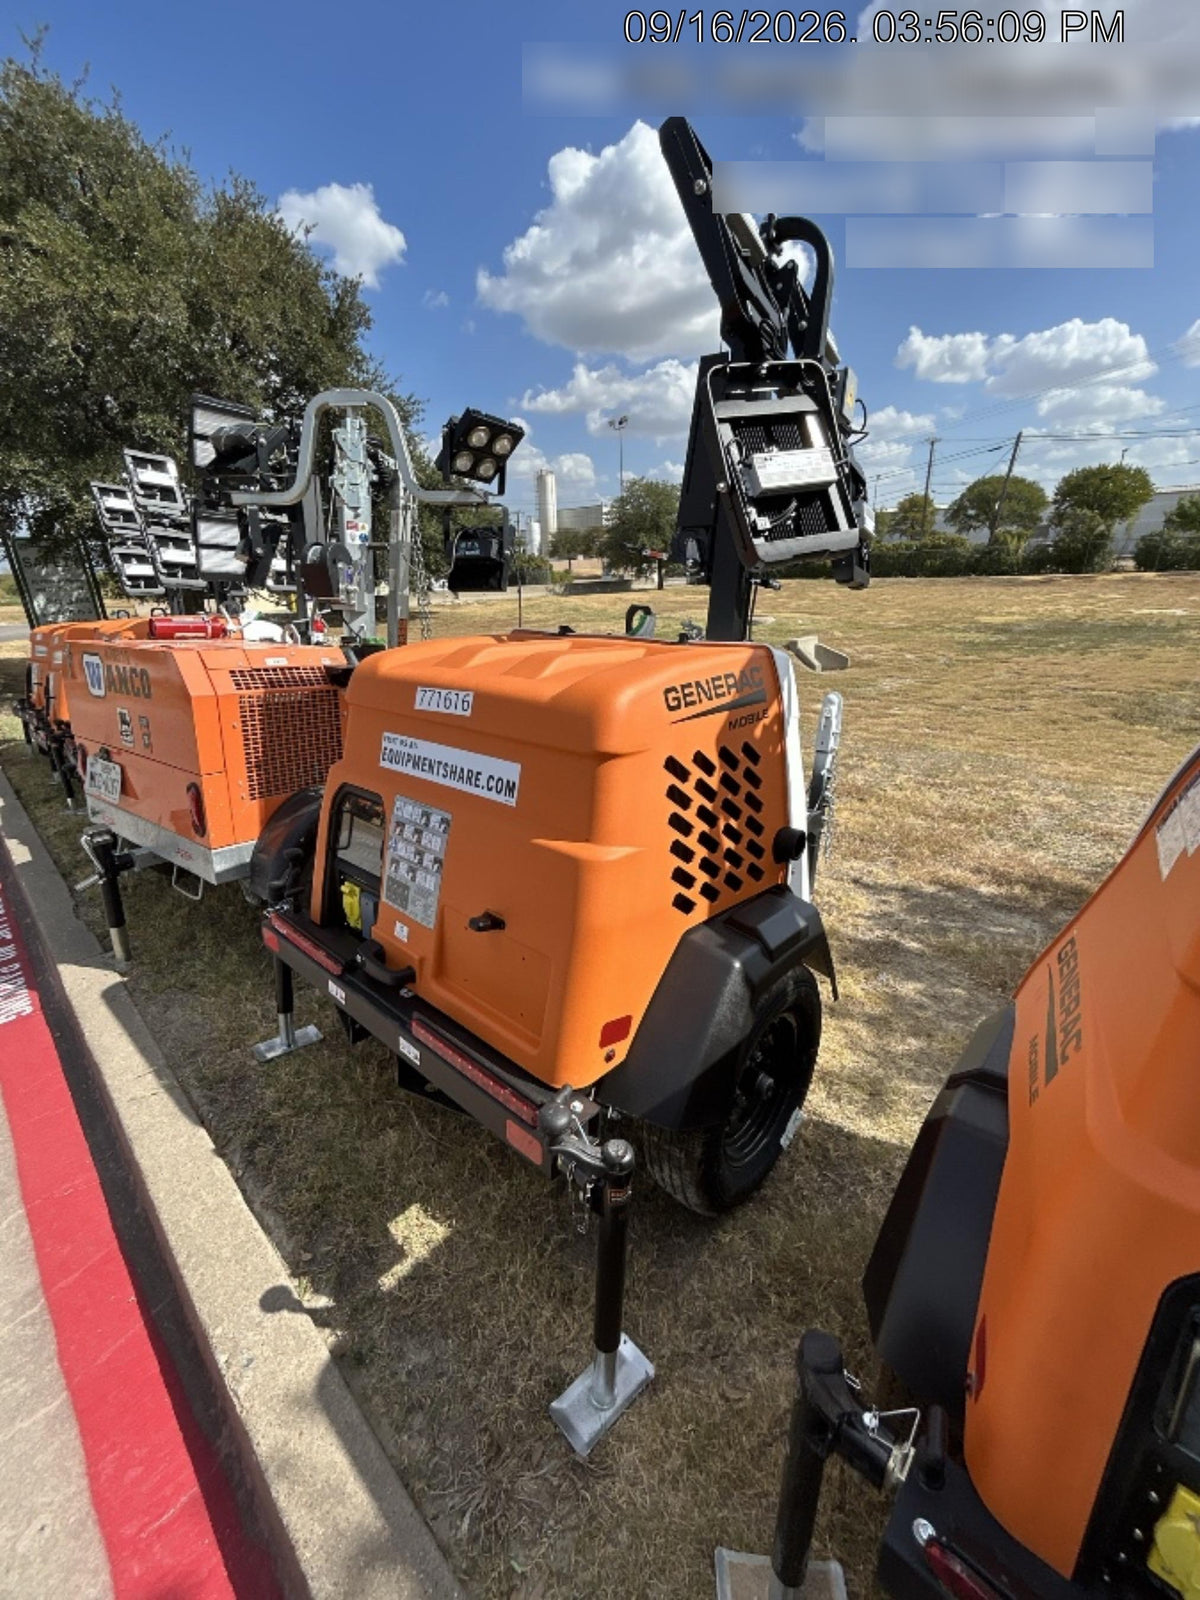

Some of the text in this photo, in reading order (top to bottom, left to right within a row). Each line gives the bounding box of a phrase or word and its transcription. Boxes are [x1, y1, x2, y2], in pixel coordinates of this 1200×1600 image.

[84, 660, 152, 699] WANCO
[419, 689, 471, 712] 771616
[663, 666, 764, 712] GENERAC
[728, 708, 769, 731] MOBILE
[381, 745, 517, 799] EQUIPMENTSHARE.COM
[1057, 936, 1082, 1066] GENERAC
